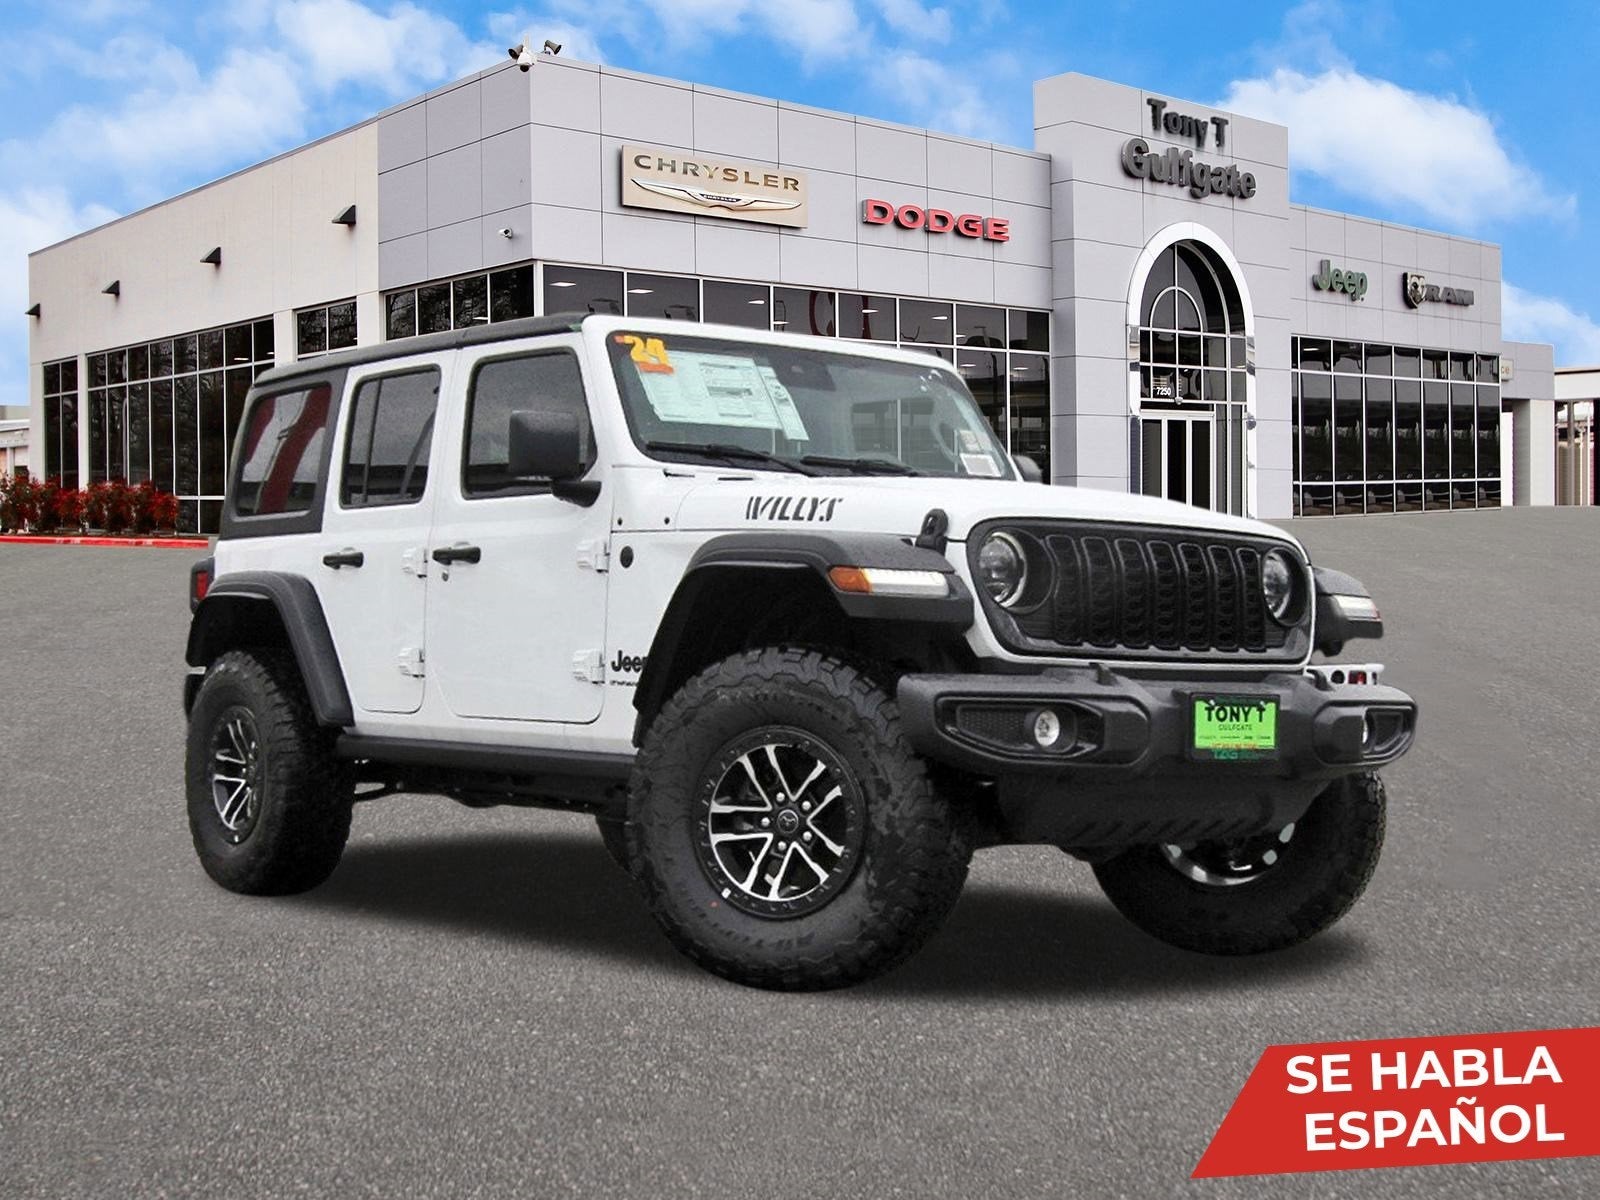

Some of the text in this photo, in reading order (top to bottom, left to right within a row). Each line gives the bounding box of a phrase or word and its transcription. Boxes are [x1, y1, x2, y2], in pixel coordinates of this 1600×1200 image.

[1147, 98, 1229, 147] Tony T
[633, 154, 801, 191] CHRYSLER
[1122, 138, 1256, 199] Gulfgate
[862, 199, 1010, 242] DODGE
[1313, 259, 1368, 302] Jeep
[1426, 284, 1475, 306] RAM
[1156, 387, 1172, 396] 7250
[746, 496, 844, 521] WILLYS
[1204, 706, 1266, 722] TONY T
